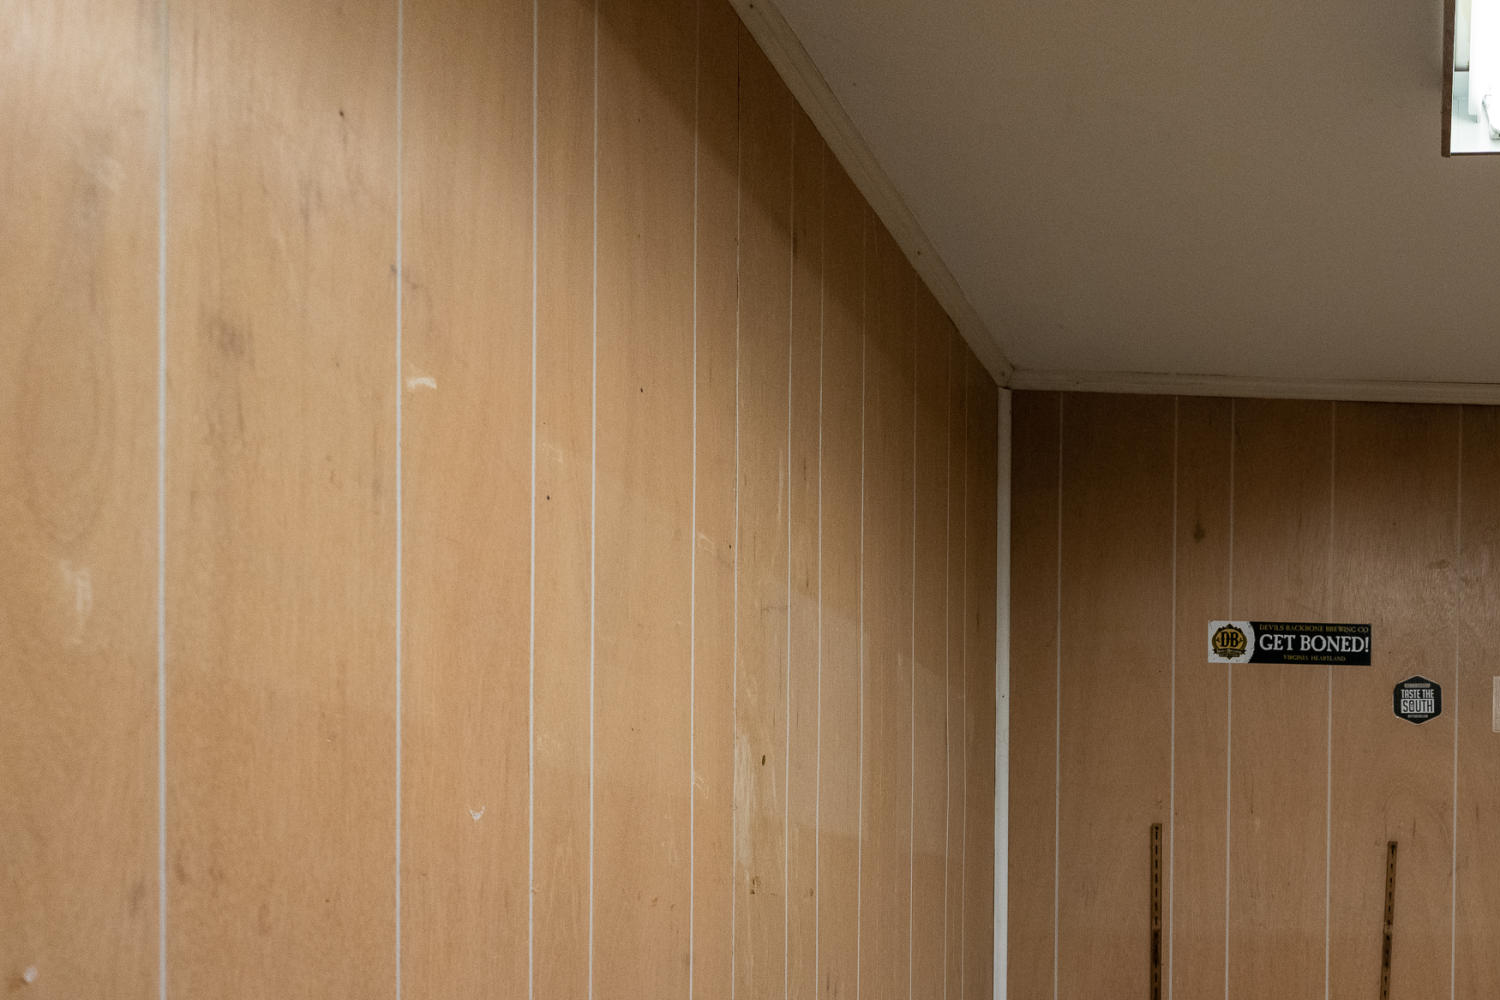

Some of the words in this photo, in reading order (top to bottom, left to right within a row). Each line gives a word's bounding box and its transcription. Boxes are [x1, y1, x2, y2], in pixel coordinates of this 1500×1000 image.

[1221, 631, 1239, 648] DB
[1259, 633, 1296, 651] GET
[1300, 634, 1369, 653] BONED!
[1400, 689, 1421, 698] TASTE
[1422, 689, 1435, 698] THE
[1402, 700, 1433, 712] SOUTH
